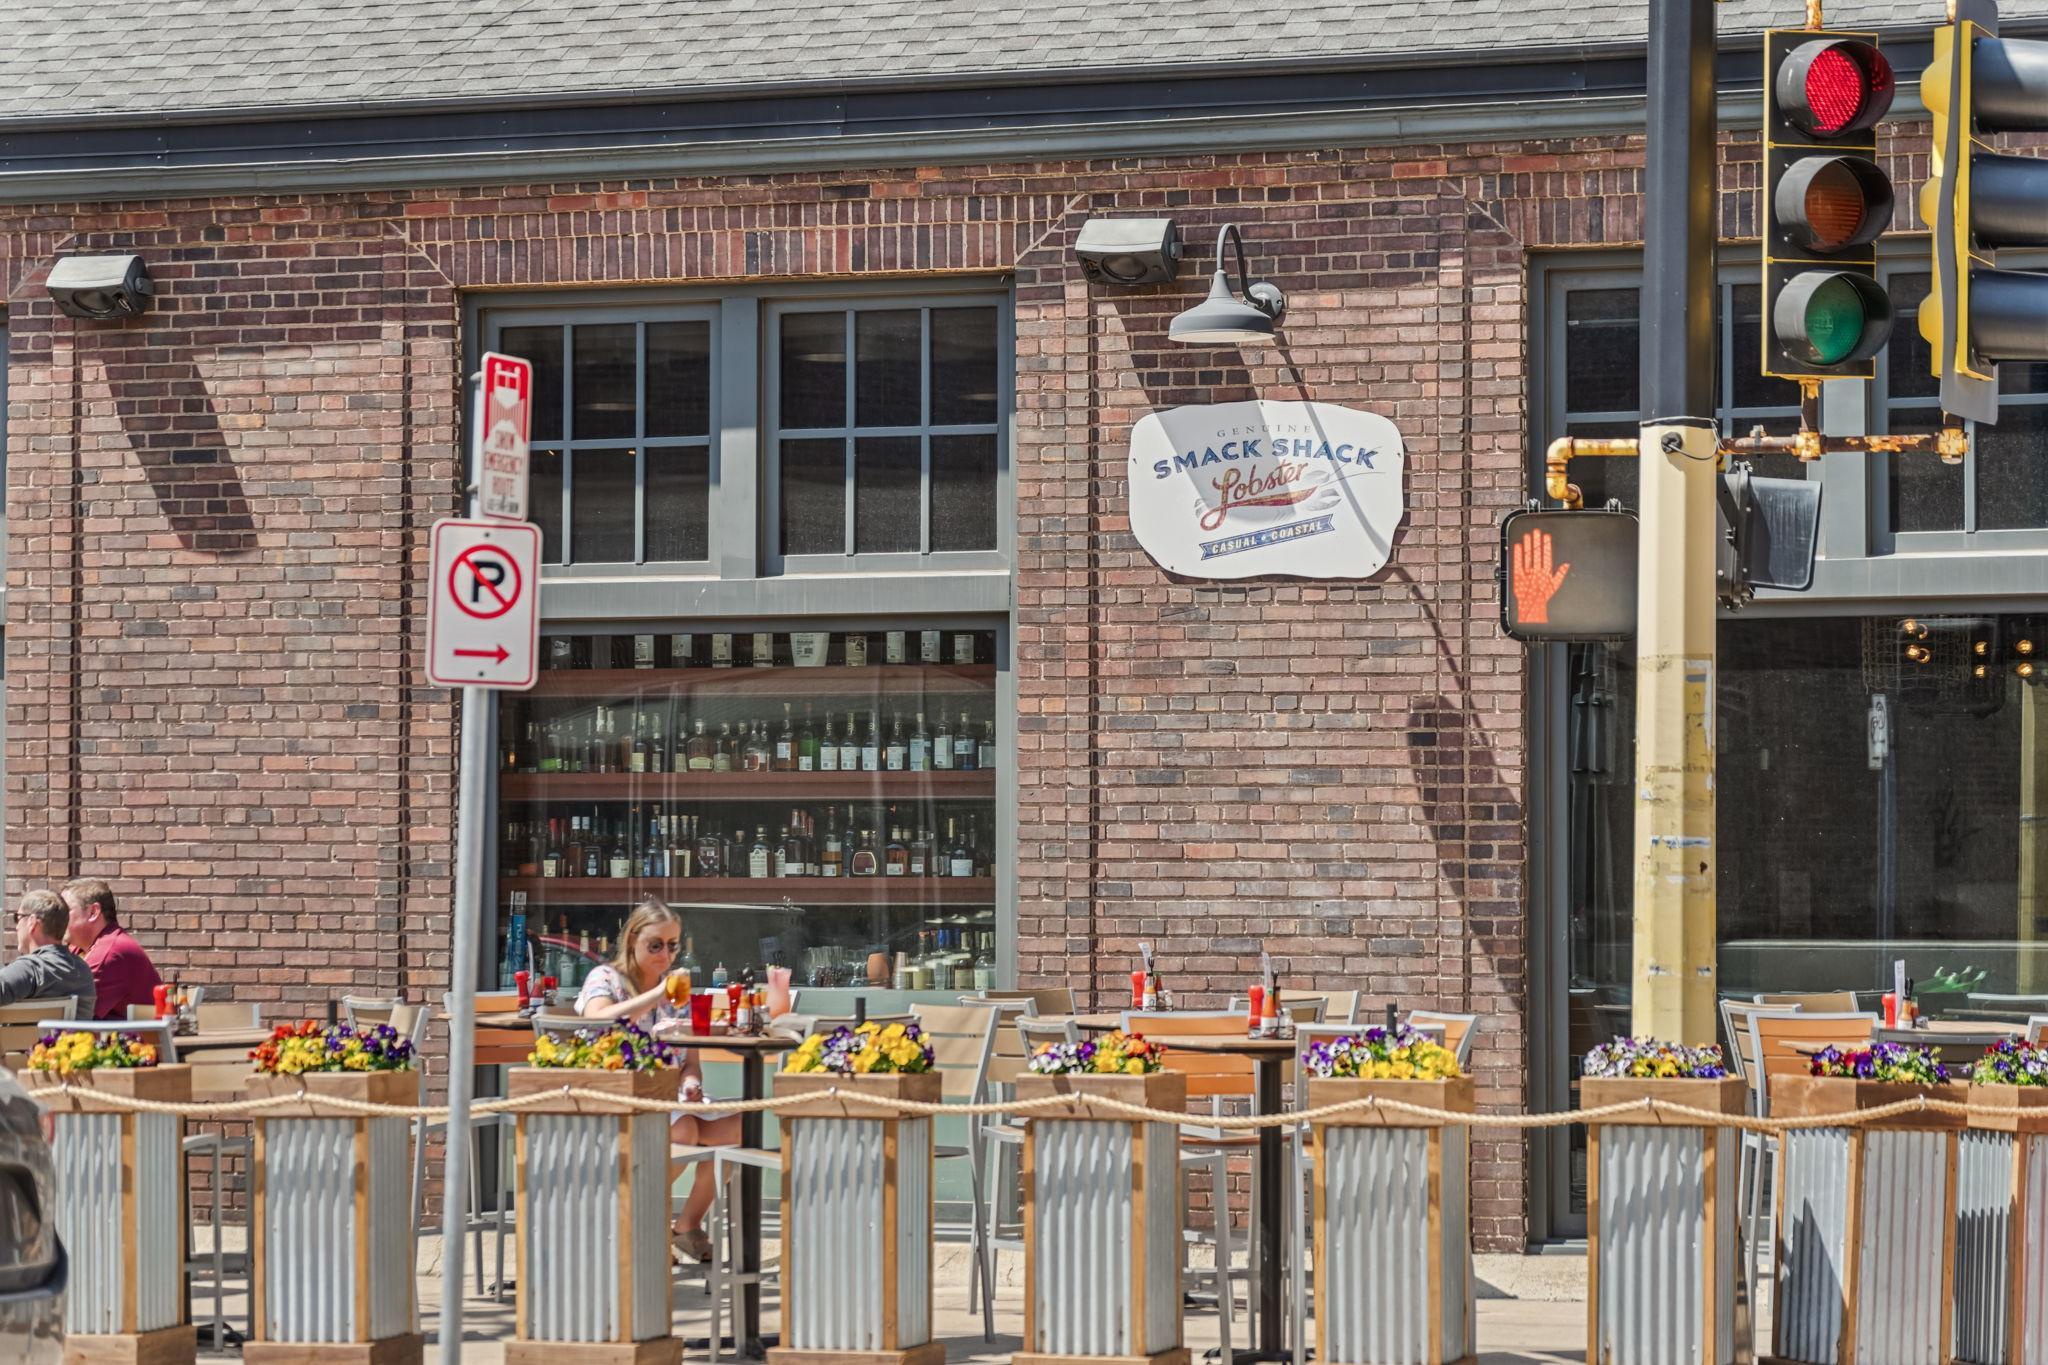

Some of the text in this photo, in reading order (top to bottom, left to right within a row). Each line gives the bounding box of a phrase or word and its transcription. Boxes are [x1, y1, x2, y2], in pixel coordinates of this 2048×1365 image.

[1217, 424, 1312, 437] GENUINE
[1154, 438, 1379, 480] SMACK SHACK
[1200, 460, 1308, 531] Lobster
[1211, 521, 1323, 553] CASUAL COASTAL
